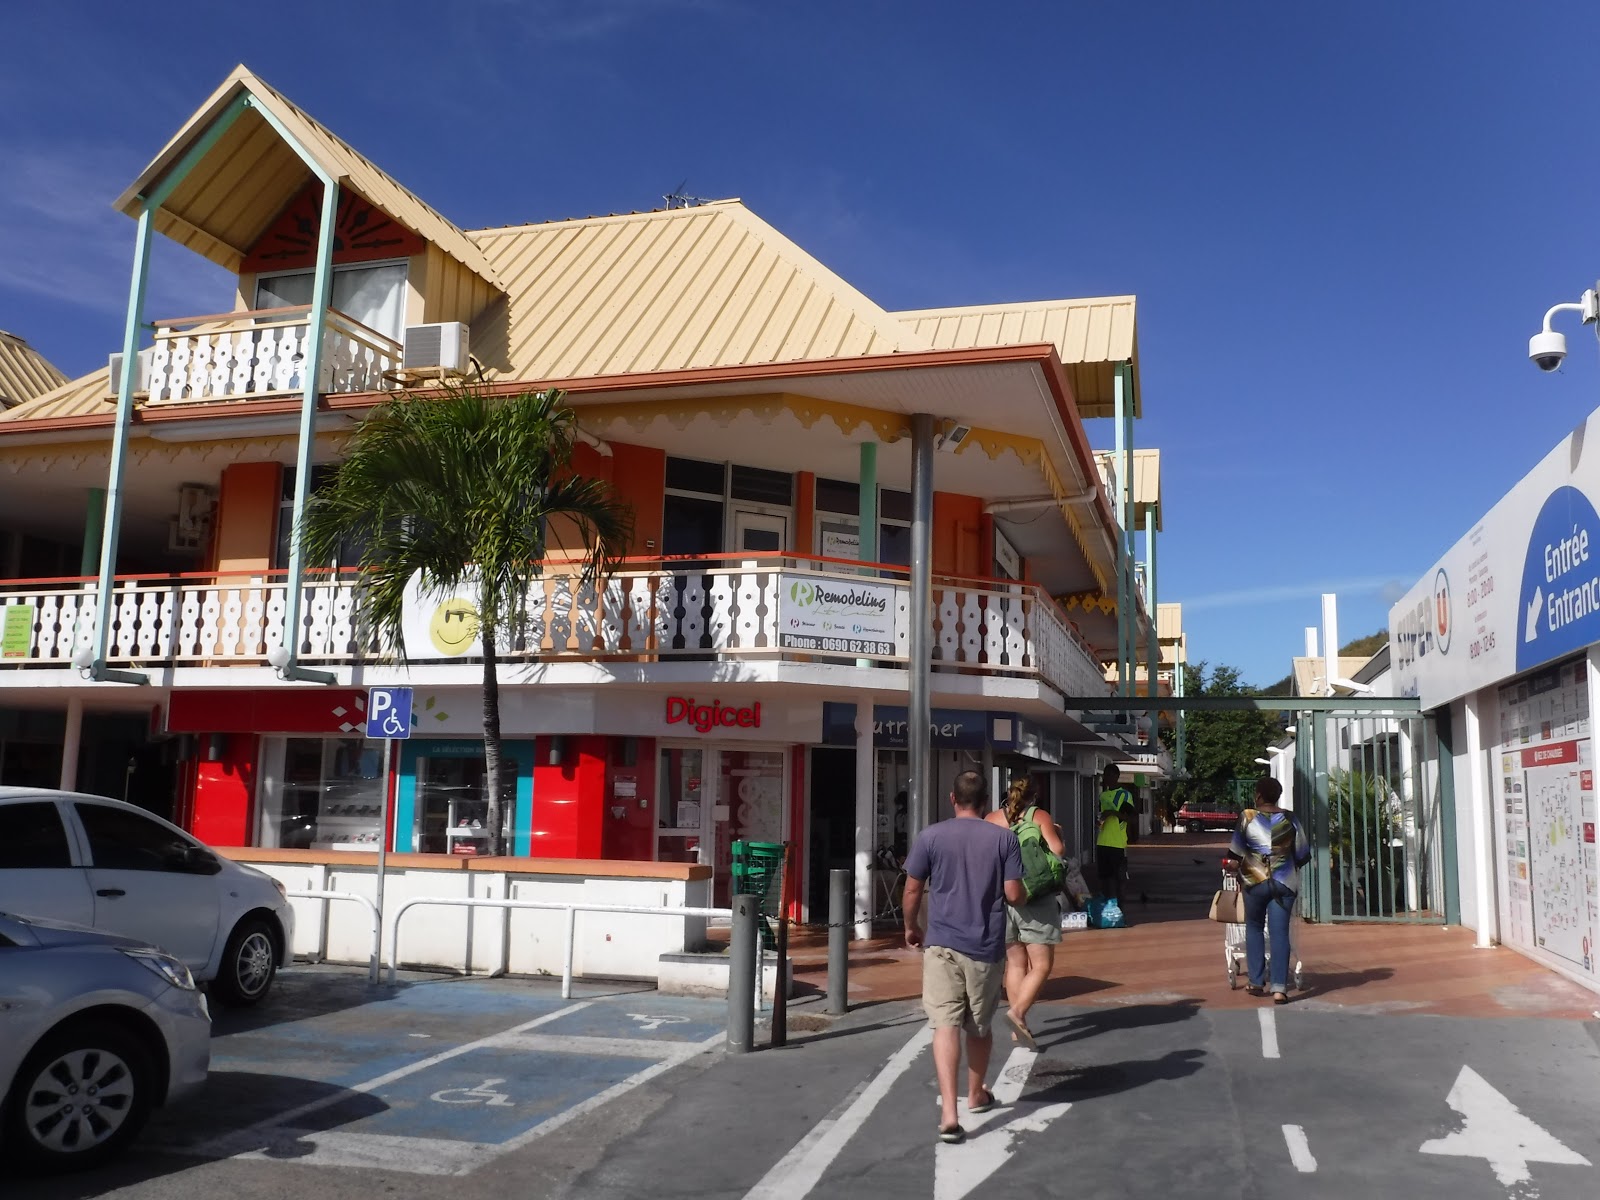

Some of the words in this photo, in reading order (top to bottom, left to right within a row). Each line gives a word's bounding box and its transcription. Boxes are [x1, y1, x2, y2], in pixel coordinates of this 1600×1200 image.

[1545, 524, 1588, 582] Entrée
[815, 585, 886, 612] Remodeling
[1548, 577, 1600, 631] Entranc
[784, 635, 816, 649] Phone
[822, 638, 848, 652] 0690
[850, 641, 861, 653] 62
[864, 642, 876, 654] 38
[877, 642, 890, 655] 63
[1398, 596, 1434, 670] SUPER
[371, 691, 391, 720] P
[666, 696, 761, 733] Digicel
